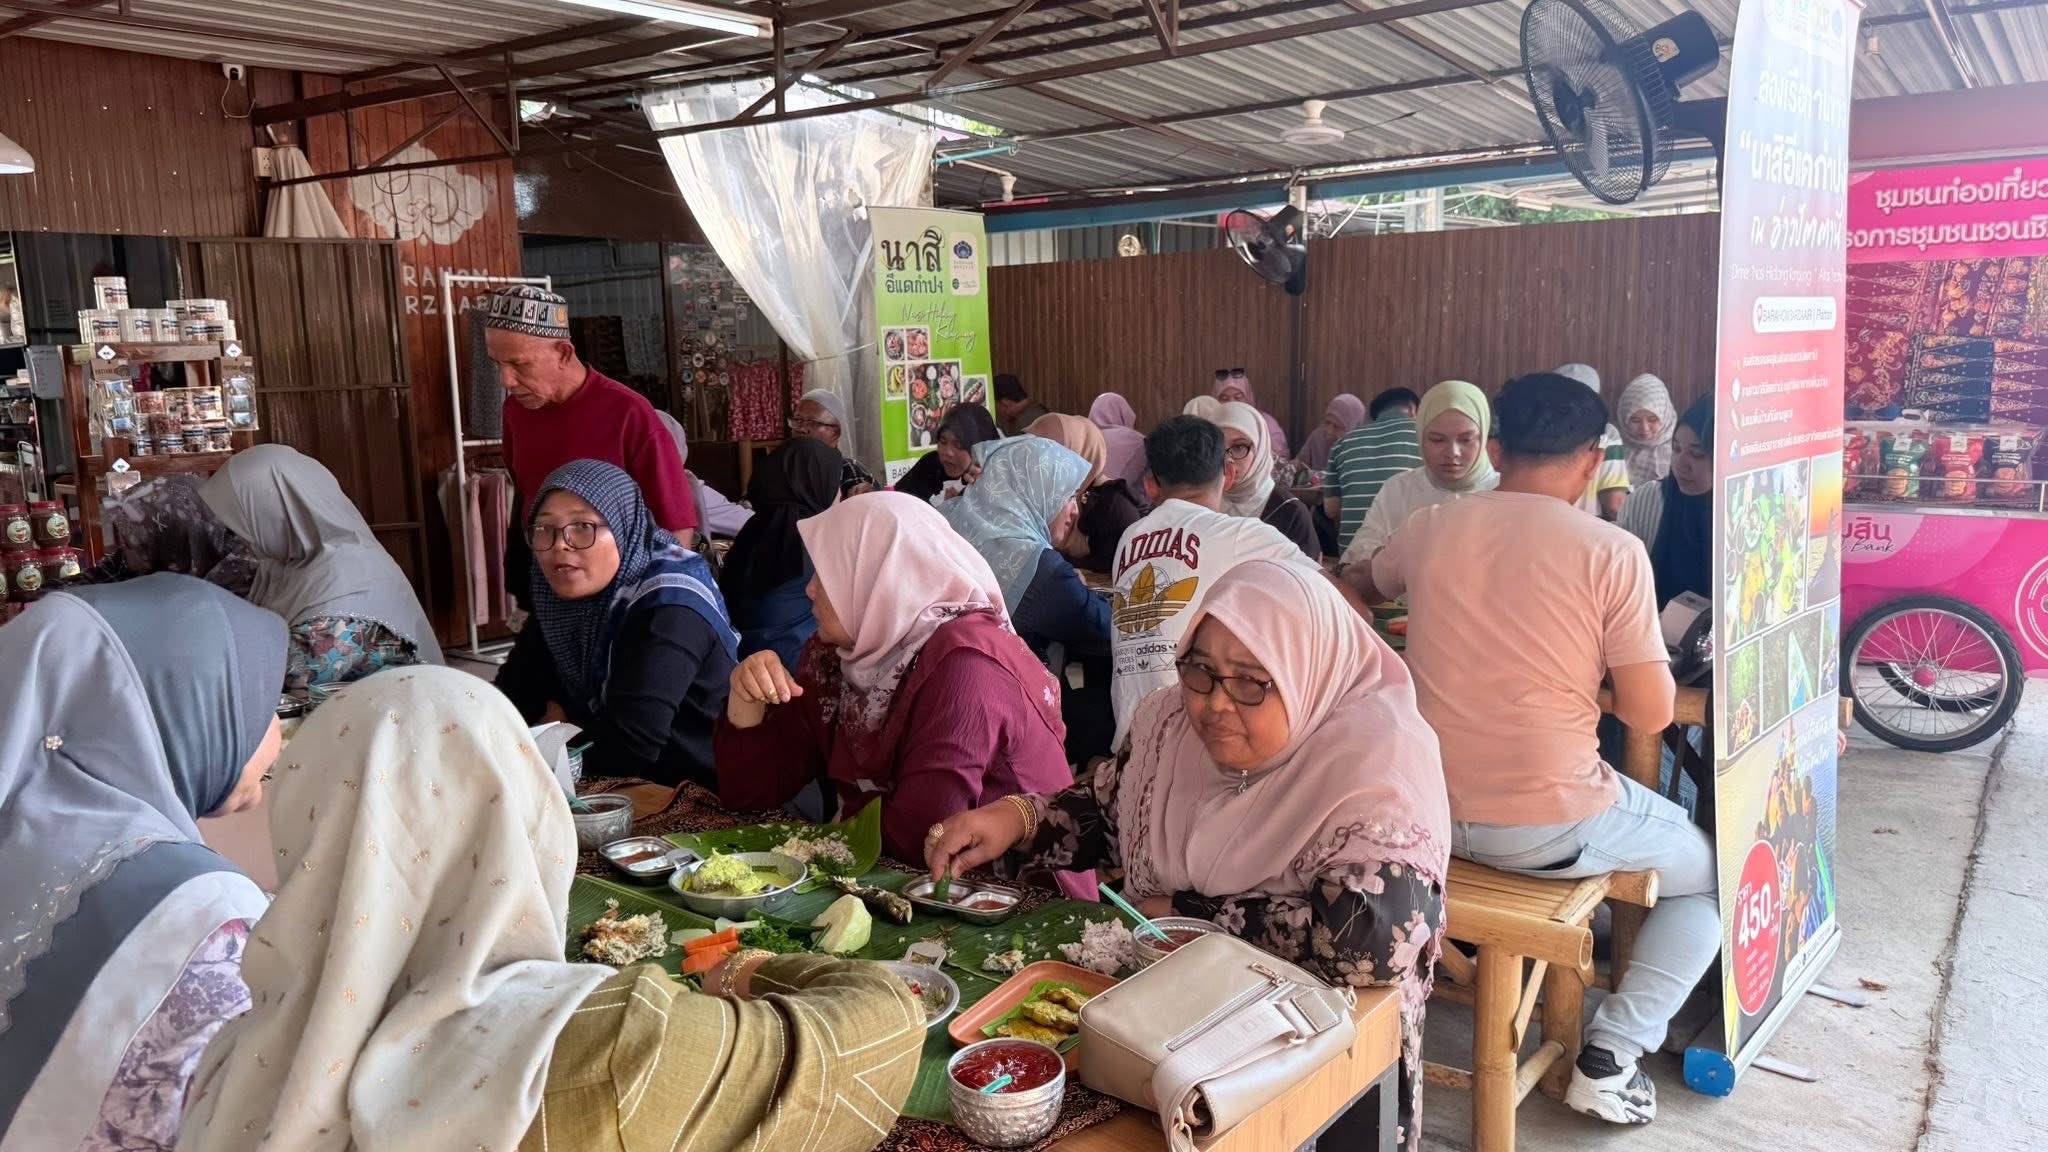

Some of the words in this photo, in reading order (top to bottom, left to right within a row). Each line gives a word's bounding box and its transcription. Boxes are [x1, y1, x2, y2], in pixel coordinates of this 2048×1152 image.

[881, 227, 943, 273] นาสิ
[886, 273, 944, 294] อีแดกำปง
[1850, 536, 1894, 552] Bank
[1114, 527, 1201, 585] ADIDAS
[1136, 643, 1167, 655] adidas
